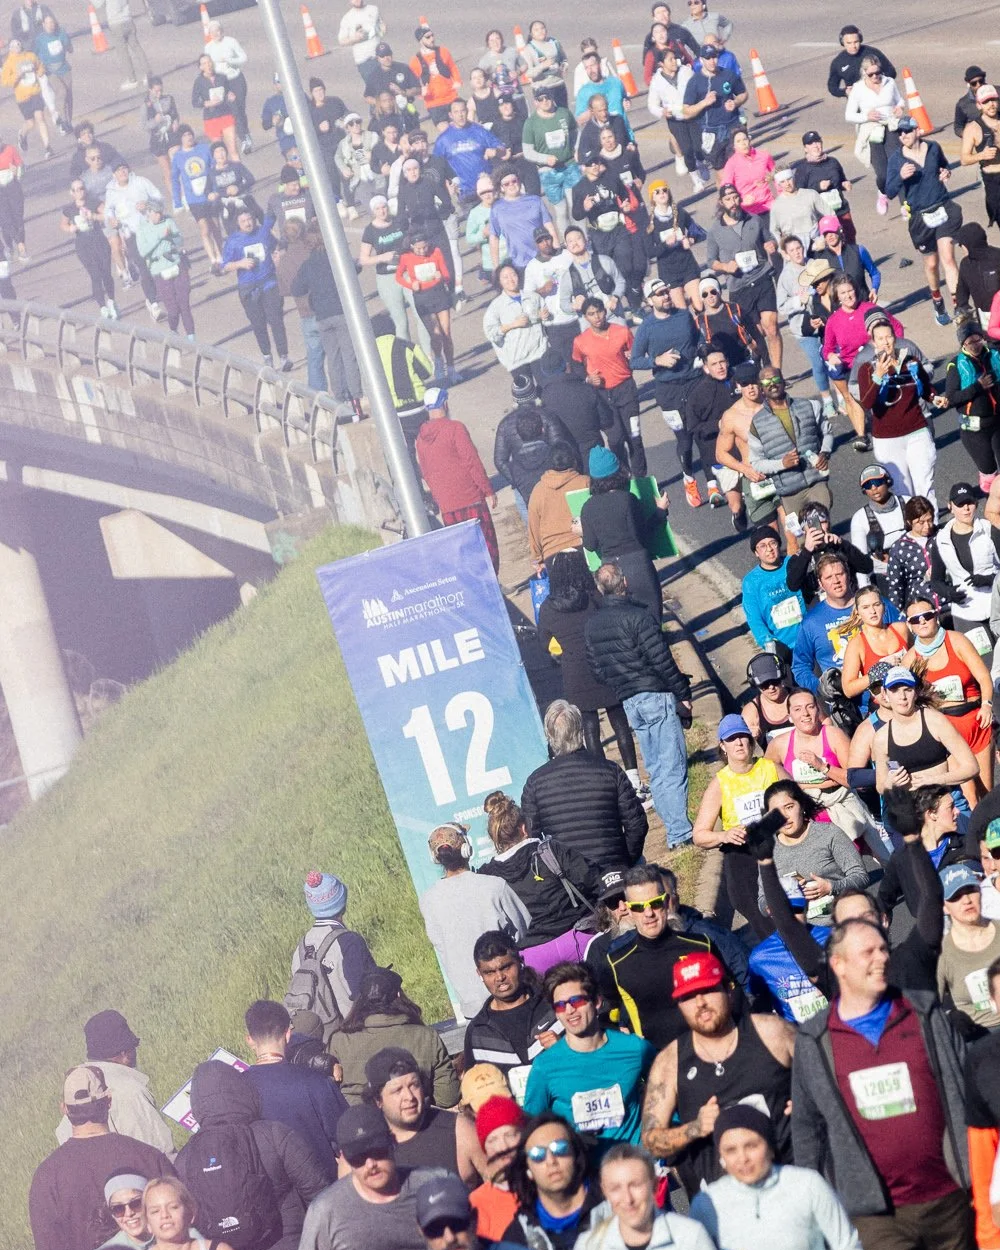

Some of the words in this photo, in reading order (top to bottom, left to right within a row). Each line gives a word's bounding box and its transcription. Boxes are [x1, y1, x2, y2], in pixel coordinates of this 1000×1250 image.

[404, 580, 438, 597] Ascension
[438, 575, 457, 587] Seton
[378, 628, 486, 688] MILE
[402, 691, 513, 806] 12
[743, 797, 762, 811] 4277
[585, 1097, 611, 1113] 3514
